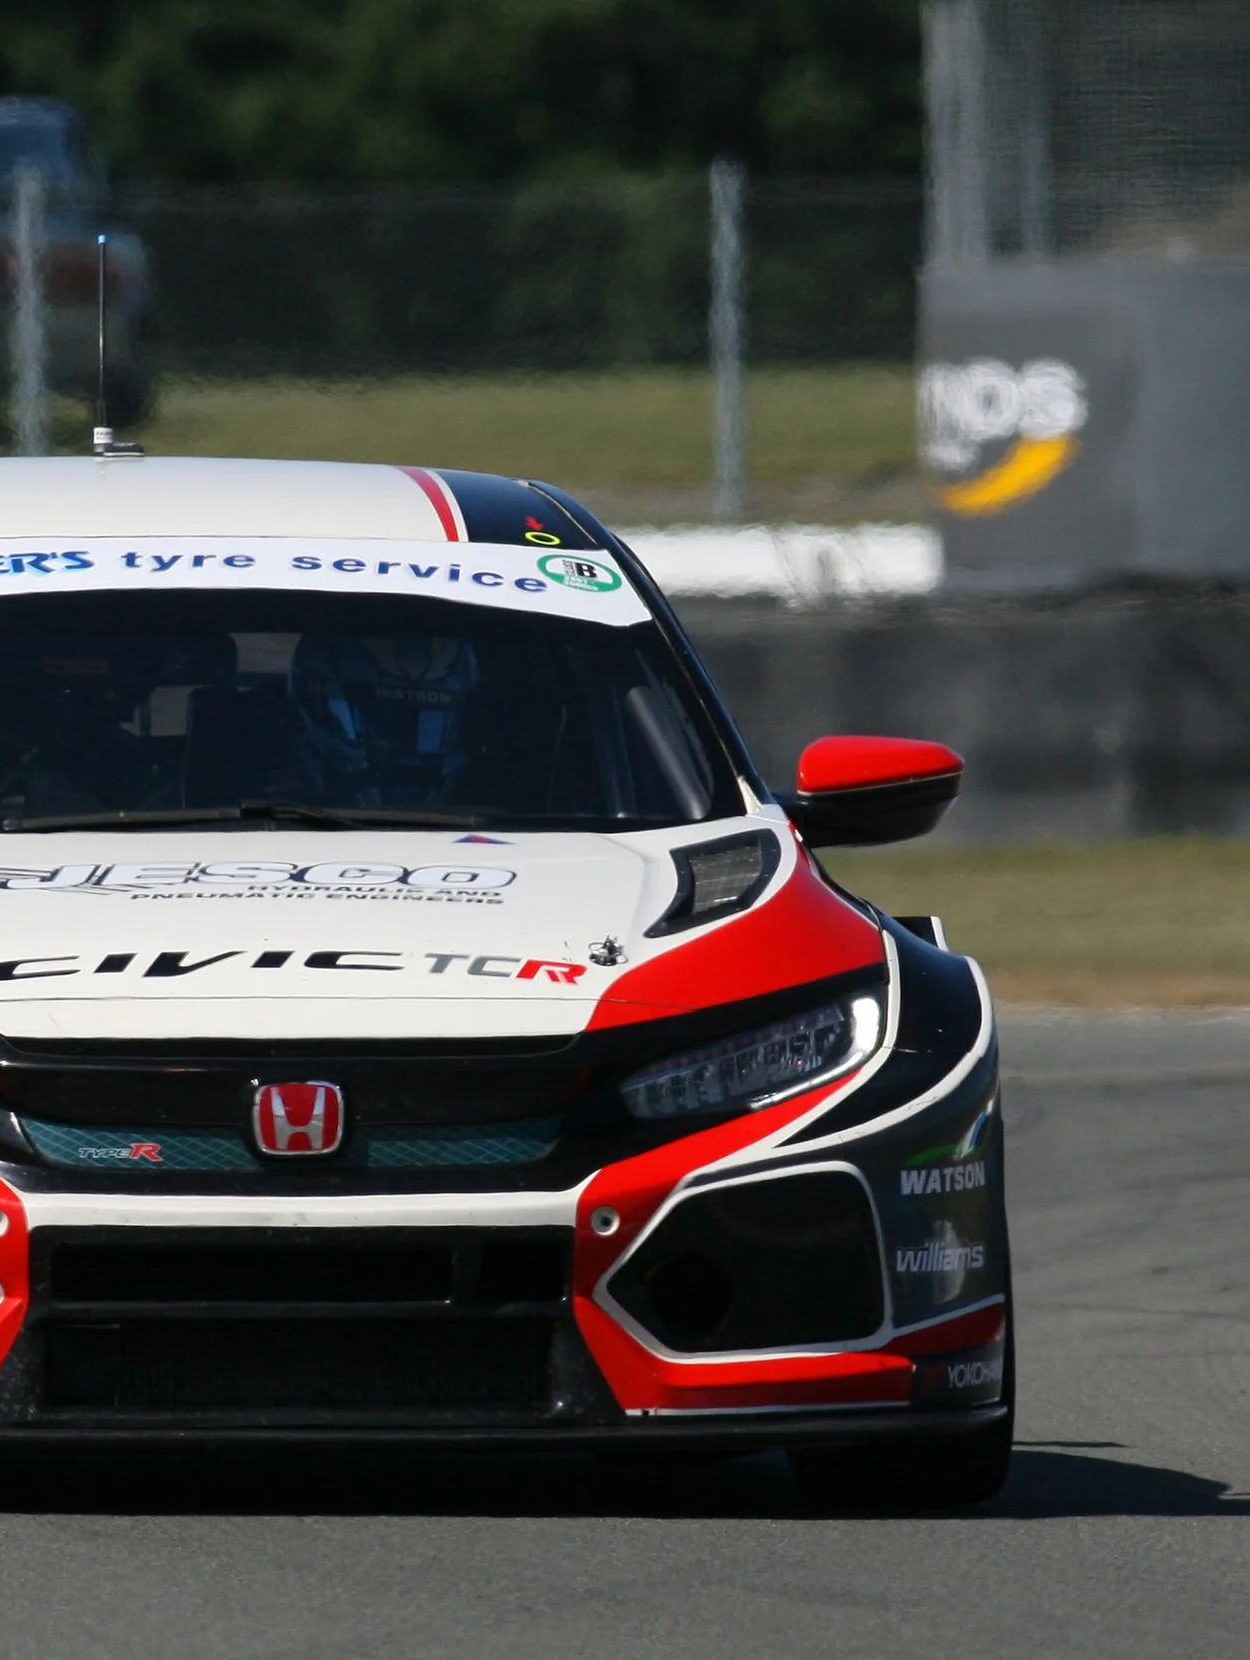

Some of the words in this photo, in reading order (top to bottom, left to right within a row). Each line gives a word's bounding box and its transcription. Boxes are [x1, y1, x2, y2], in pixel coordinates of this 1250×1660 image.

[121, 551, 255, 572] tyre
[291, 554, 548, 594] service
[131, 892, 316, 900] PNEUMATIC
[327, 894, 505, 905] ENGINEERS
[248, 886, 424, 894] HYDRAULIC
[433, 889, 502, 898] AND
[424, 952, 588, 985] TCR
[900, 1161, 986, 1195] WATSON
